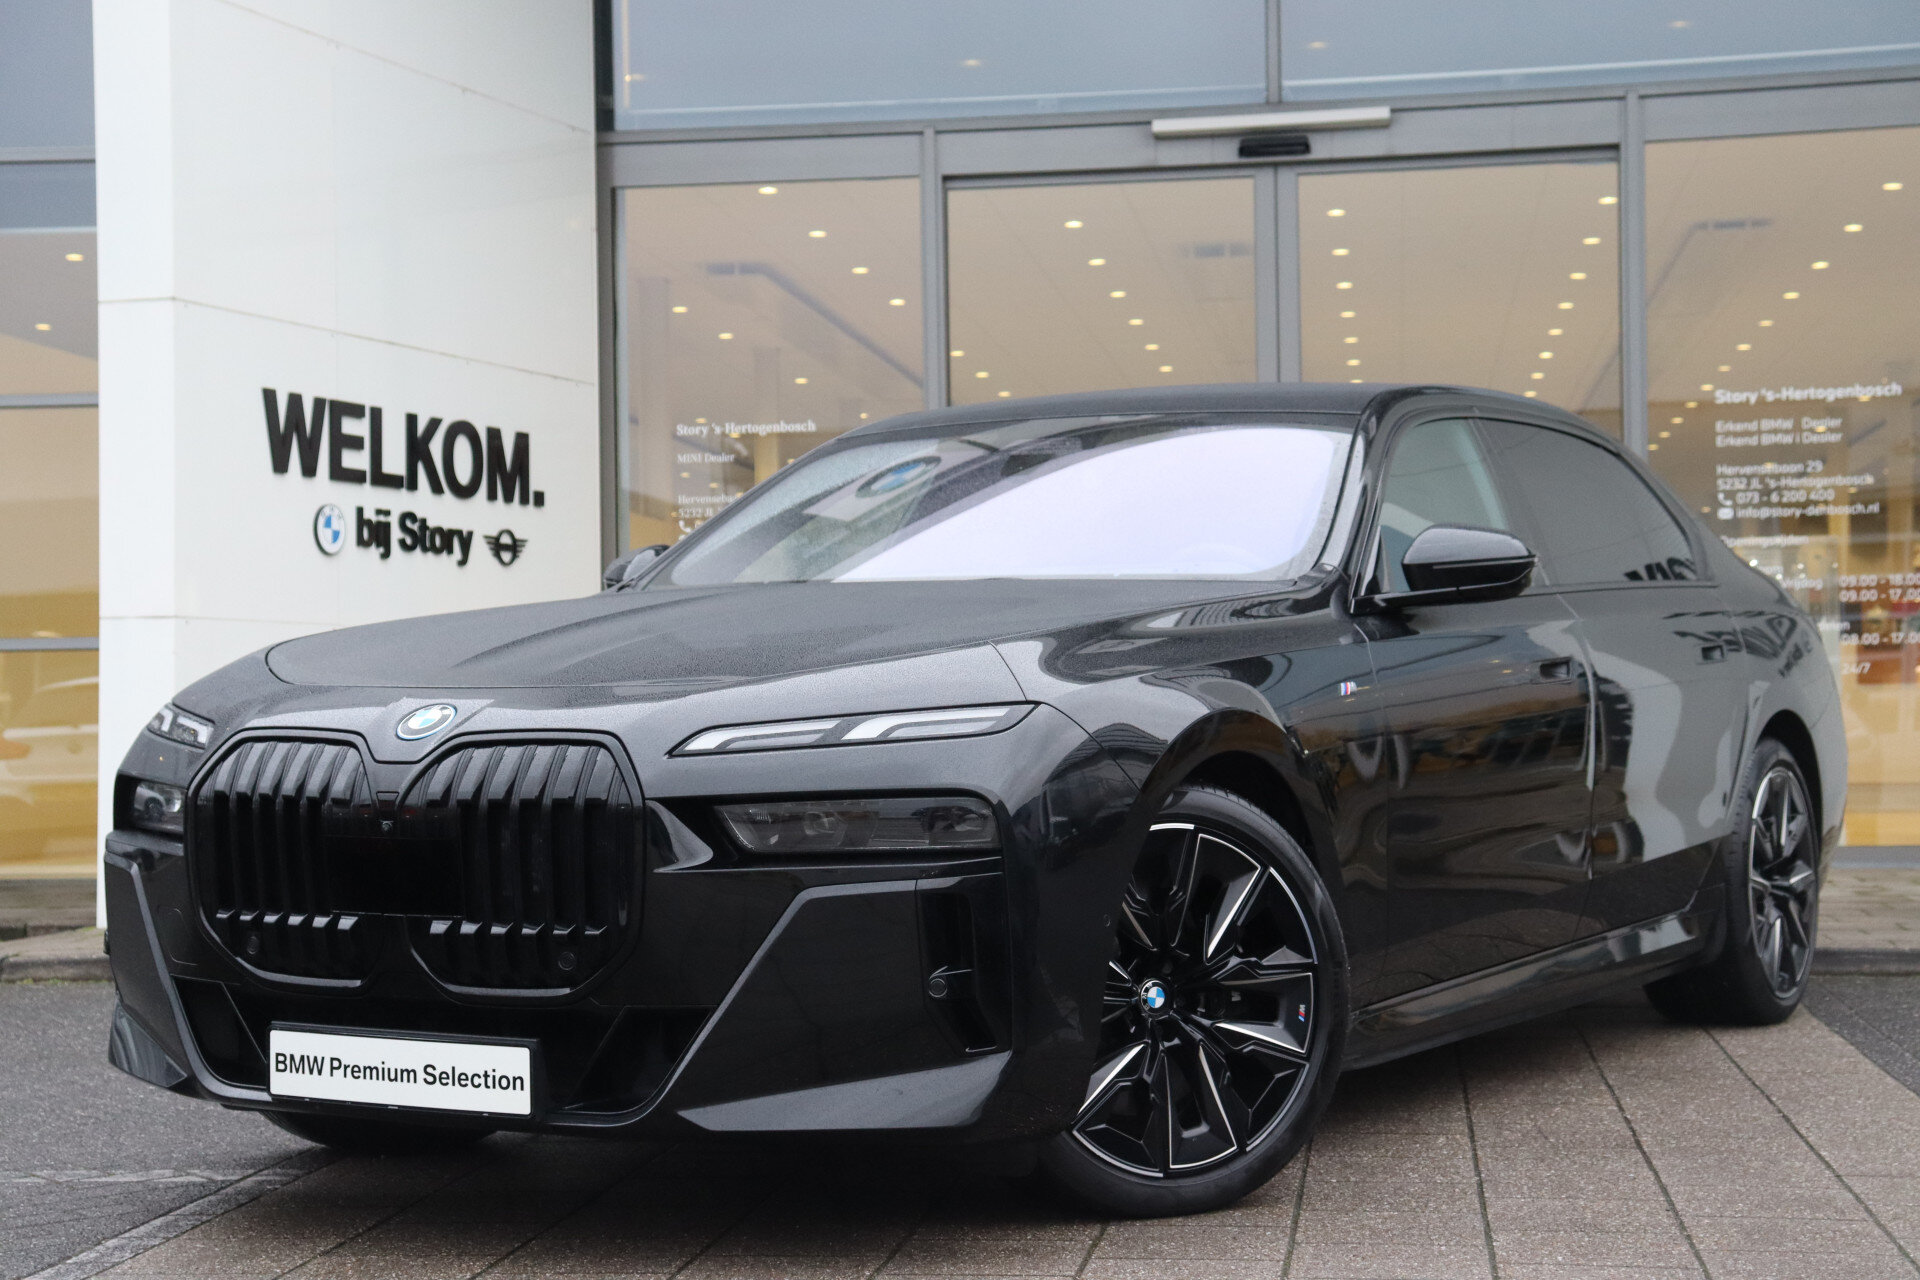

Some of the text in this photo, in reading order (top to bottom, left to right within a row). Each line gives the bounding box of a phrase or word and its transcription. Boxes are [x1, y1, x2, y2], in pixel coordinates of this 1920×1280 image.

[1714, 388, 1759, 404] Story
[676, 423, 708, 437] Story
[1715, 420, 1758, 433] Erkend
[1760, 418, 1794, 431] BMW
[262, 387, 545, 507] WELKOM.
[1715, 434, 1758, 447] Erkend
[1760, 432, 1794, 446] BMW
[1801, 432, 1843, 444] Dealer
[677, 452, 735, 463] MINI Dealer
[1735, 490, 1760, 504] 073
[1781, 489, 1808, 502] 200
[1809, 488, 1836, 501] 400
[355, 506, 473, 567] bij Story
[274, 1052, 525, 1091] BMW Premium Selection
